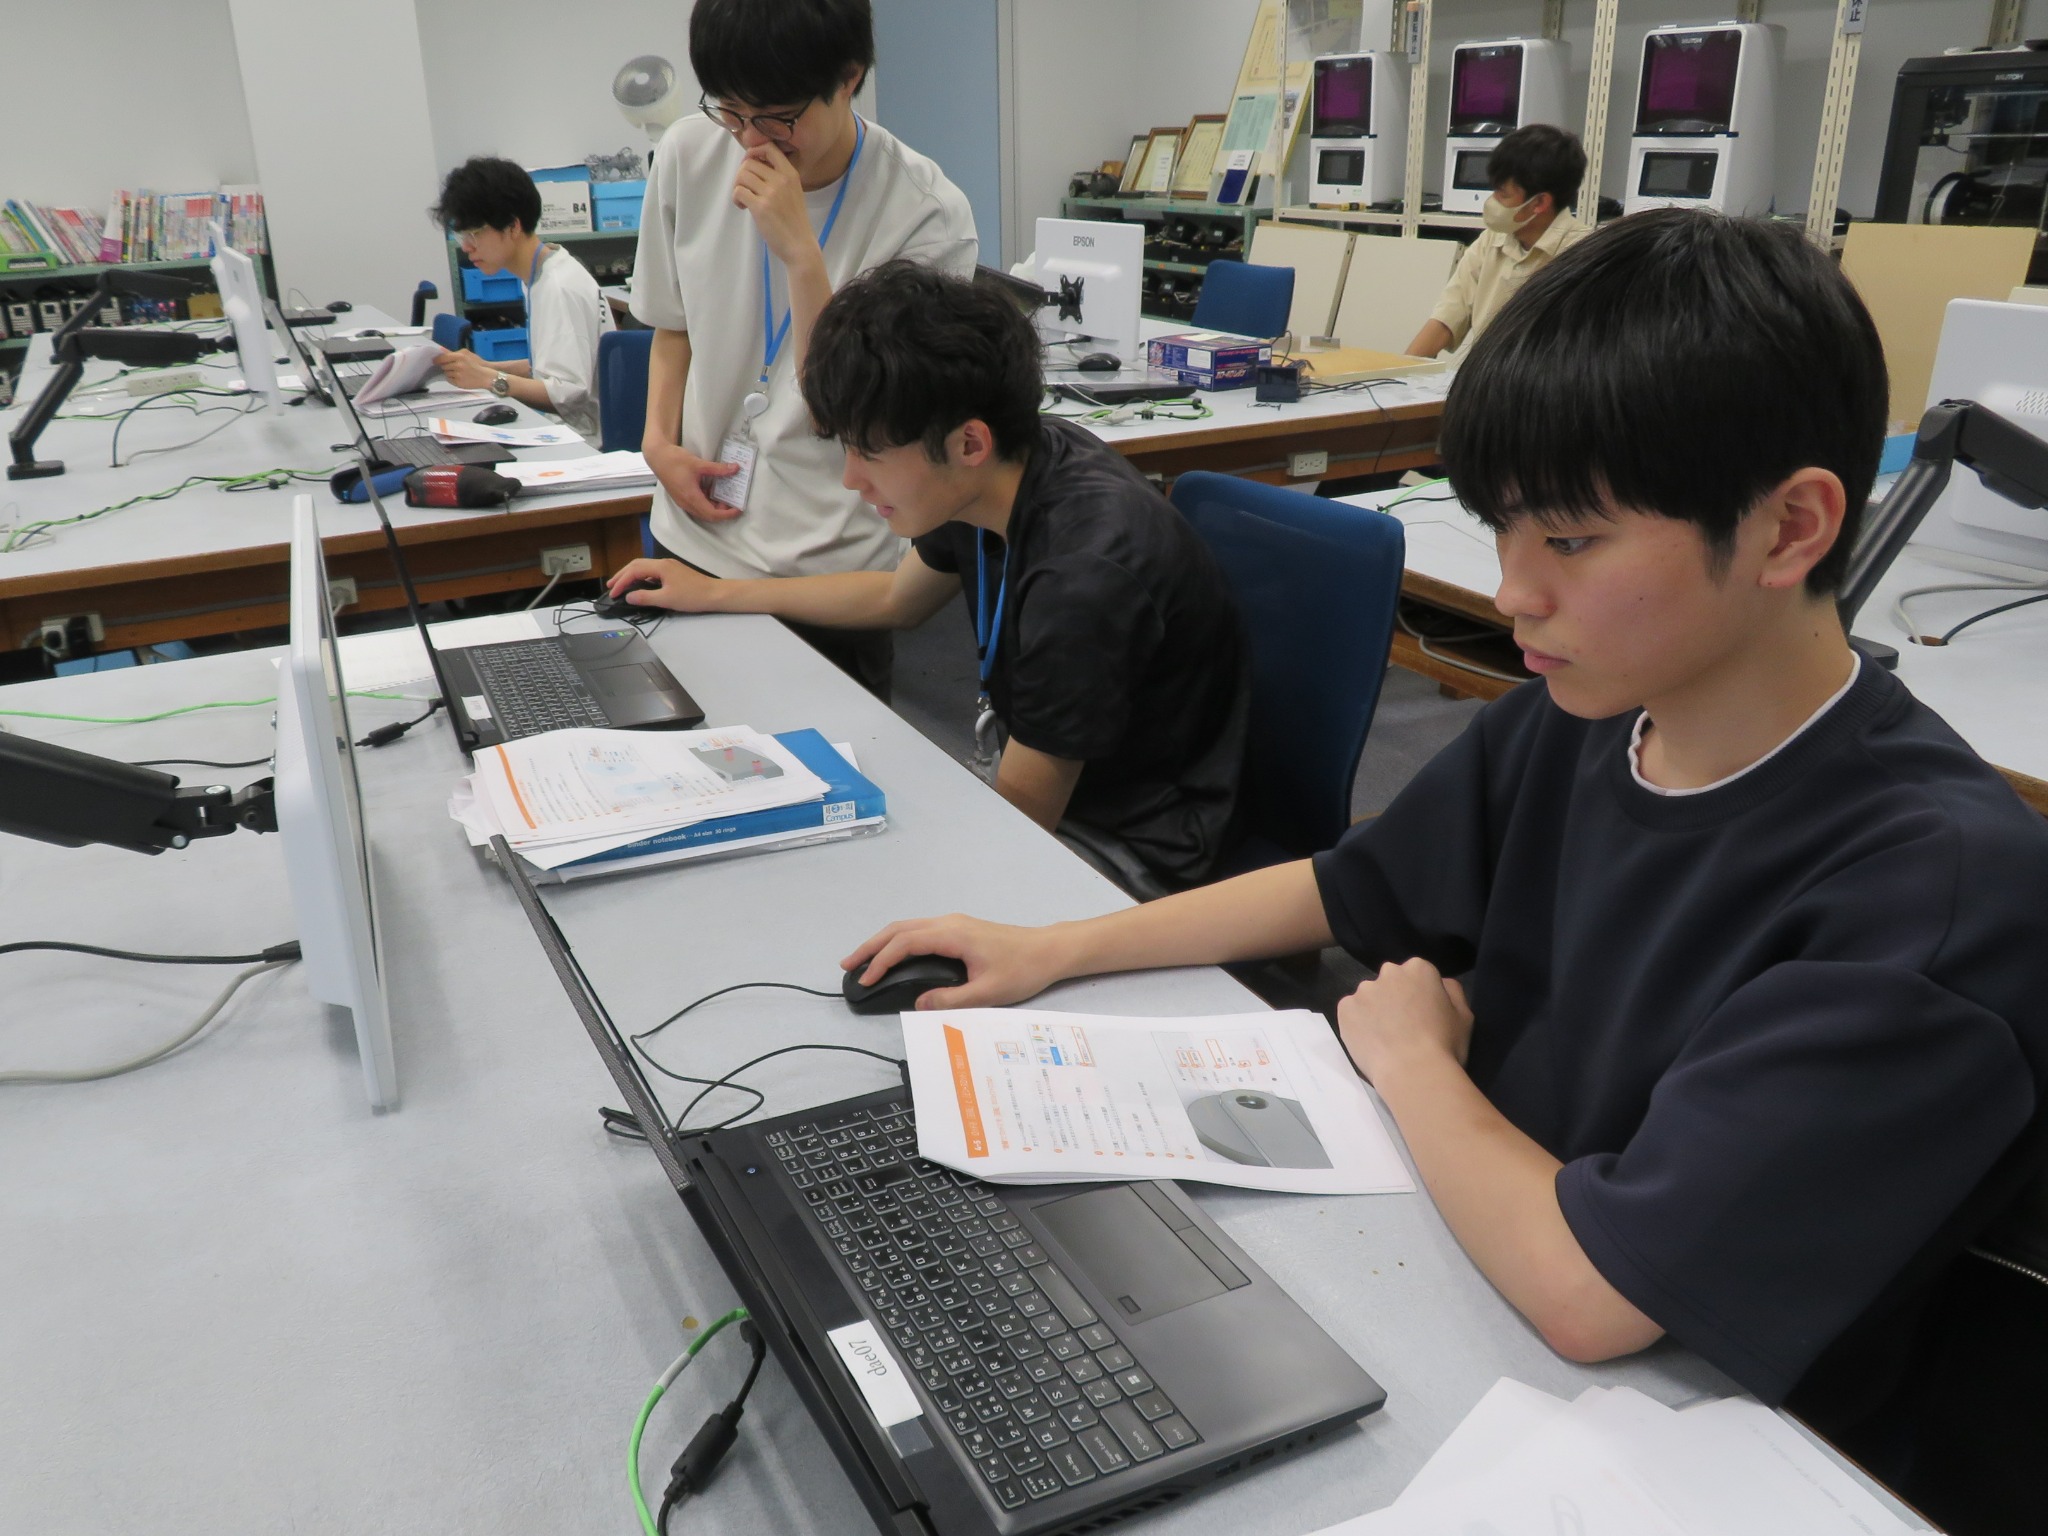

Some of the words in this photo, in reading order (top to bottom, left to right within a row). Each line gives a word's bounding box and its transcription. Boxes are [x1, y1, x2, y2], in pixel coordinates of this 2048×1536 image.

[573, 202, 587, 213] B4
[1073, 236, 1095, 247] EPSON
[826, 813, 854, 822] Campus
[652, 834, 686, 845] notebook
[723, 826, 737, 835] rings
[973, 1139, 982, 1151] 4-5
[840, 1243, 849, 1251] F12
[852, 1261, 860, 1269] F11
[915, 1257, 926, 1265] O
[993, 1263, 1004, 1271] M
[862, 1278, 872, 1287] F10
[1009, 1283, 1019, 1291] N
[943, 1297, 954, 1305] U
[986, 1303, 996, 1311] H
[1001, 1324, 1012, 1332] G
[945, 1336, 955, 1344] 6
[1058, 1346, 1069, 1355] C
[848, 1340, 887, 1376] dae07
[914, 1357, 923, 1365] F6
[960, 1358, 970, 1366] 5
[989, 1361, 1000, 1370] R
[1035, 1368, 1046, 1376] D
[1076, 1368, 1086, 1377] X
[928, 1378, 937, 1386] F5
[1007, 1385, 1017, 1393] E
[1052, 1391, 1063, 1399] S
[1094, 1392, 1105, 1400] Z
[943, 1400, 951, 1408] F4
[992, 1404, 1003, 1413] 3
[1022, 1408, 1034, 1418] W
[1071, 1415, 1082, 1423] A
[956, 1421, 966, 1430] F3
[1010, 1429, 1020, 1438] 2
[1041, 1432, 1053, 1443] Q
[1132, 1430, 1144, 1444] Shift
[1172, 1428, 1184, 1440] Ctrl
[971, 1444, 981, 1454] F2
[989, 1470, 997, 1478] F1
